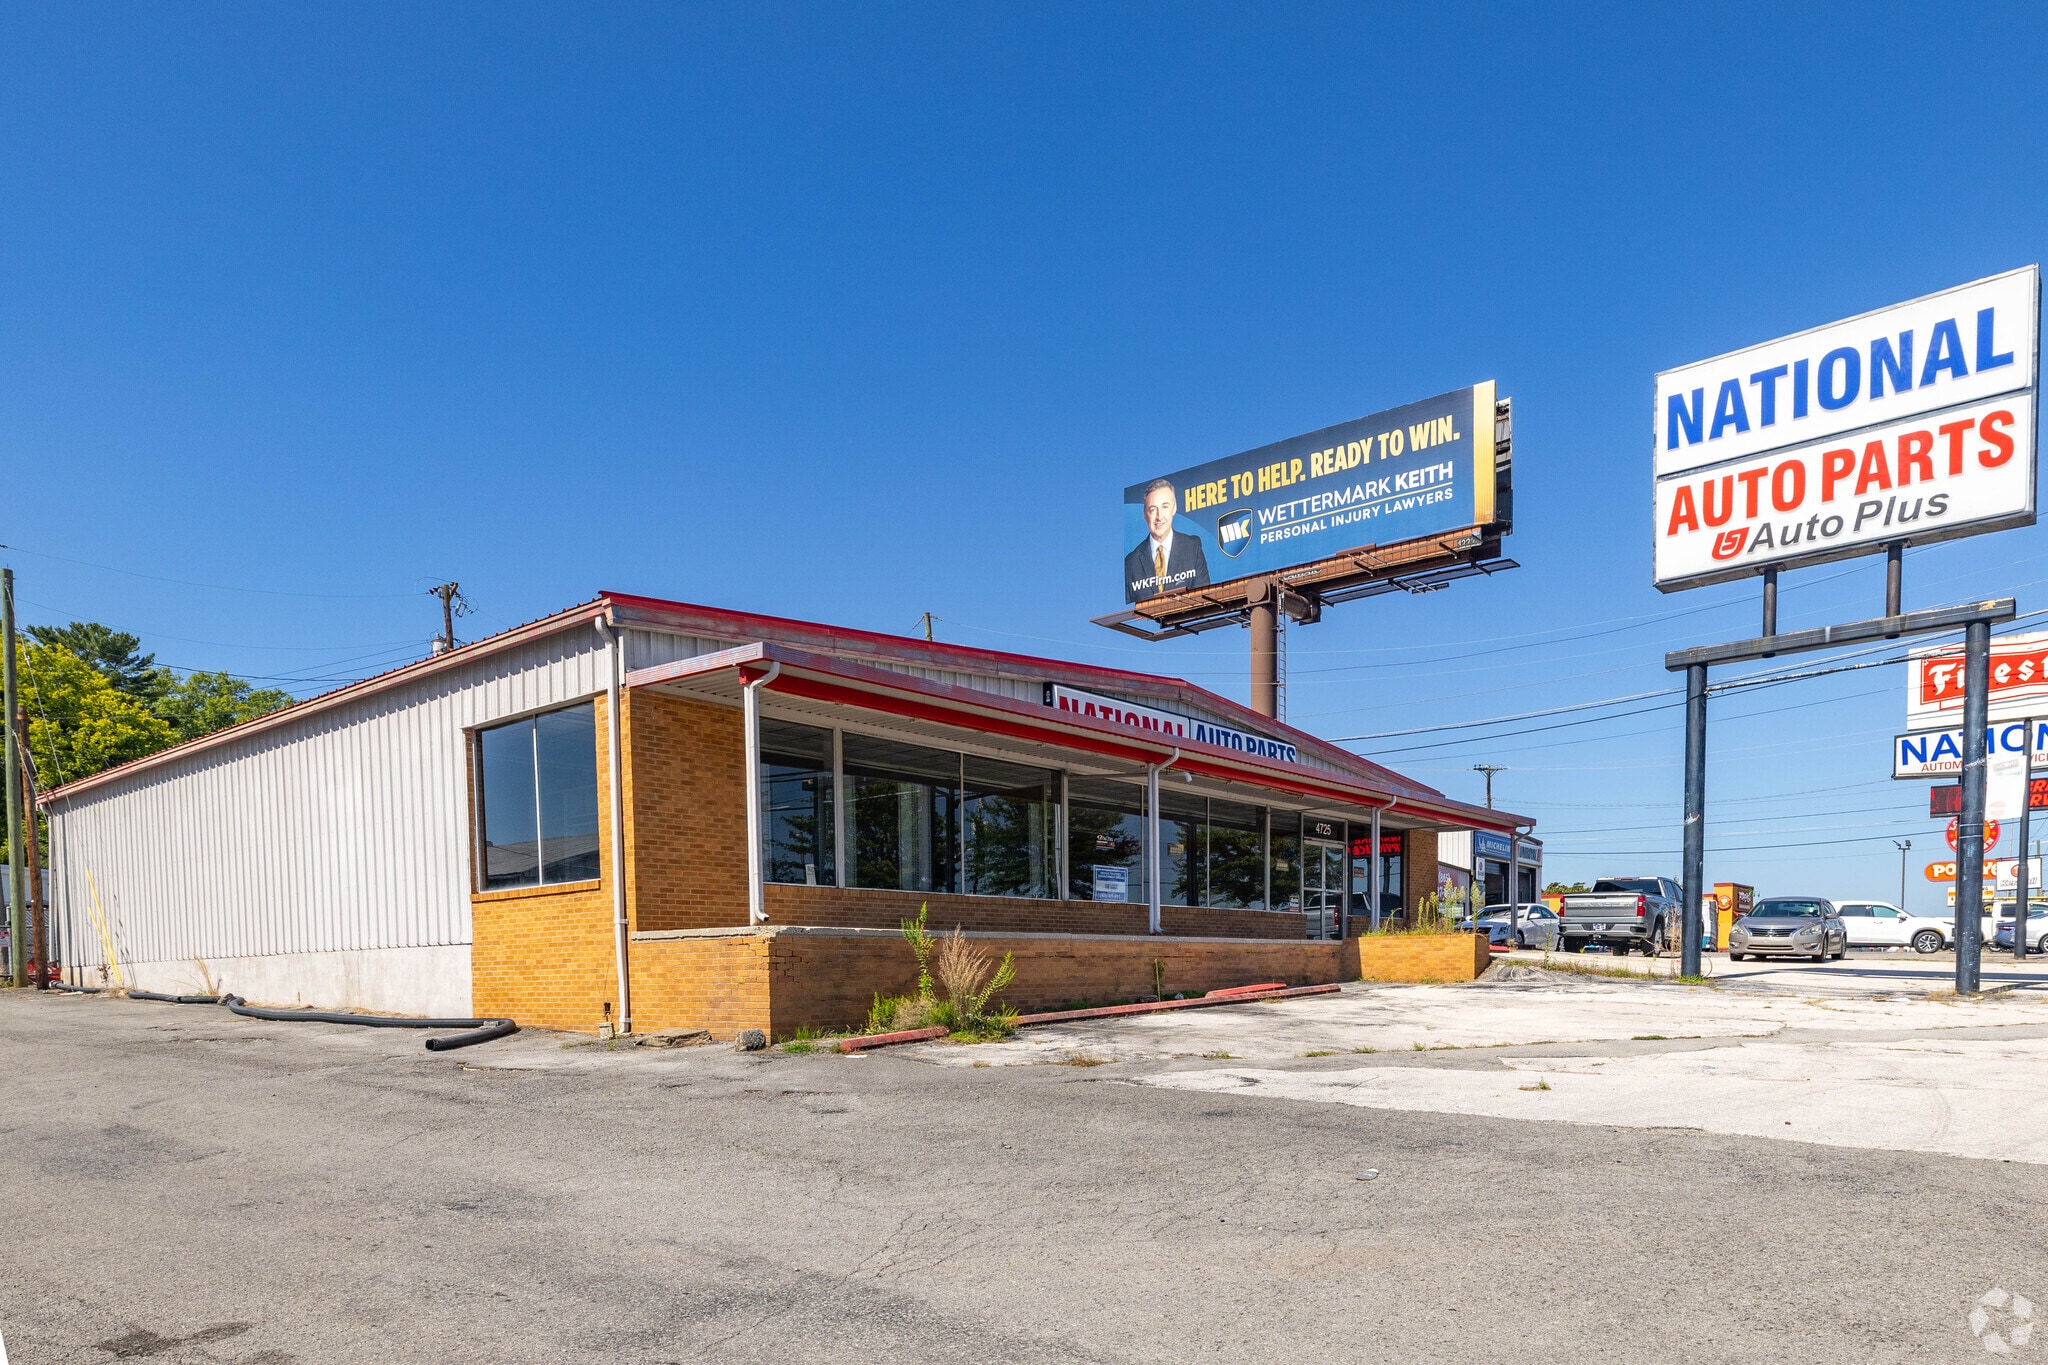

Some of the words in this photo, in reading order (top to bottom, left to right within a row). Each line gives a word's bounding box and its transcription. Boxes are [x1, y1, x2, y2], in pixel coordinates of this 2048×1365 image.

[1667, 306, 2015, 452] NATIONAL
[1184, 478, 1228, 513] HERE
[1231, 471, 1254, 499] TO
[1257, 458, 1306, 493] HELP.
[1310, 436, 1373, 479] READY
[1377, 429, 1404, 459] TO
[1409, 415, 1461, 451] WIN.
[1258, 476, 1392, 525] WETTERMARK
[1395, 461, 1454, 492] KEITH
[1667, 459, 1806, 536] AUTO
[1821, 410, 2015, 503] PARTS
[1260, 518, 1328, 545] PERSONAL
[1331, 505, 1381, 528] INJURY
[1385, 488, 1454, 514] LAWYERS
[1747, 514, 1844, 553] Auto
[1853, 493, 1950, 532] Plus
[1131, 569, 1196, 592] WKFirm.com
[1315, 823, 1332, 836] 4725
